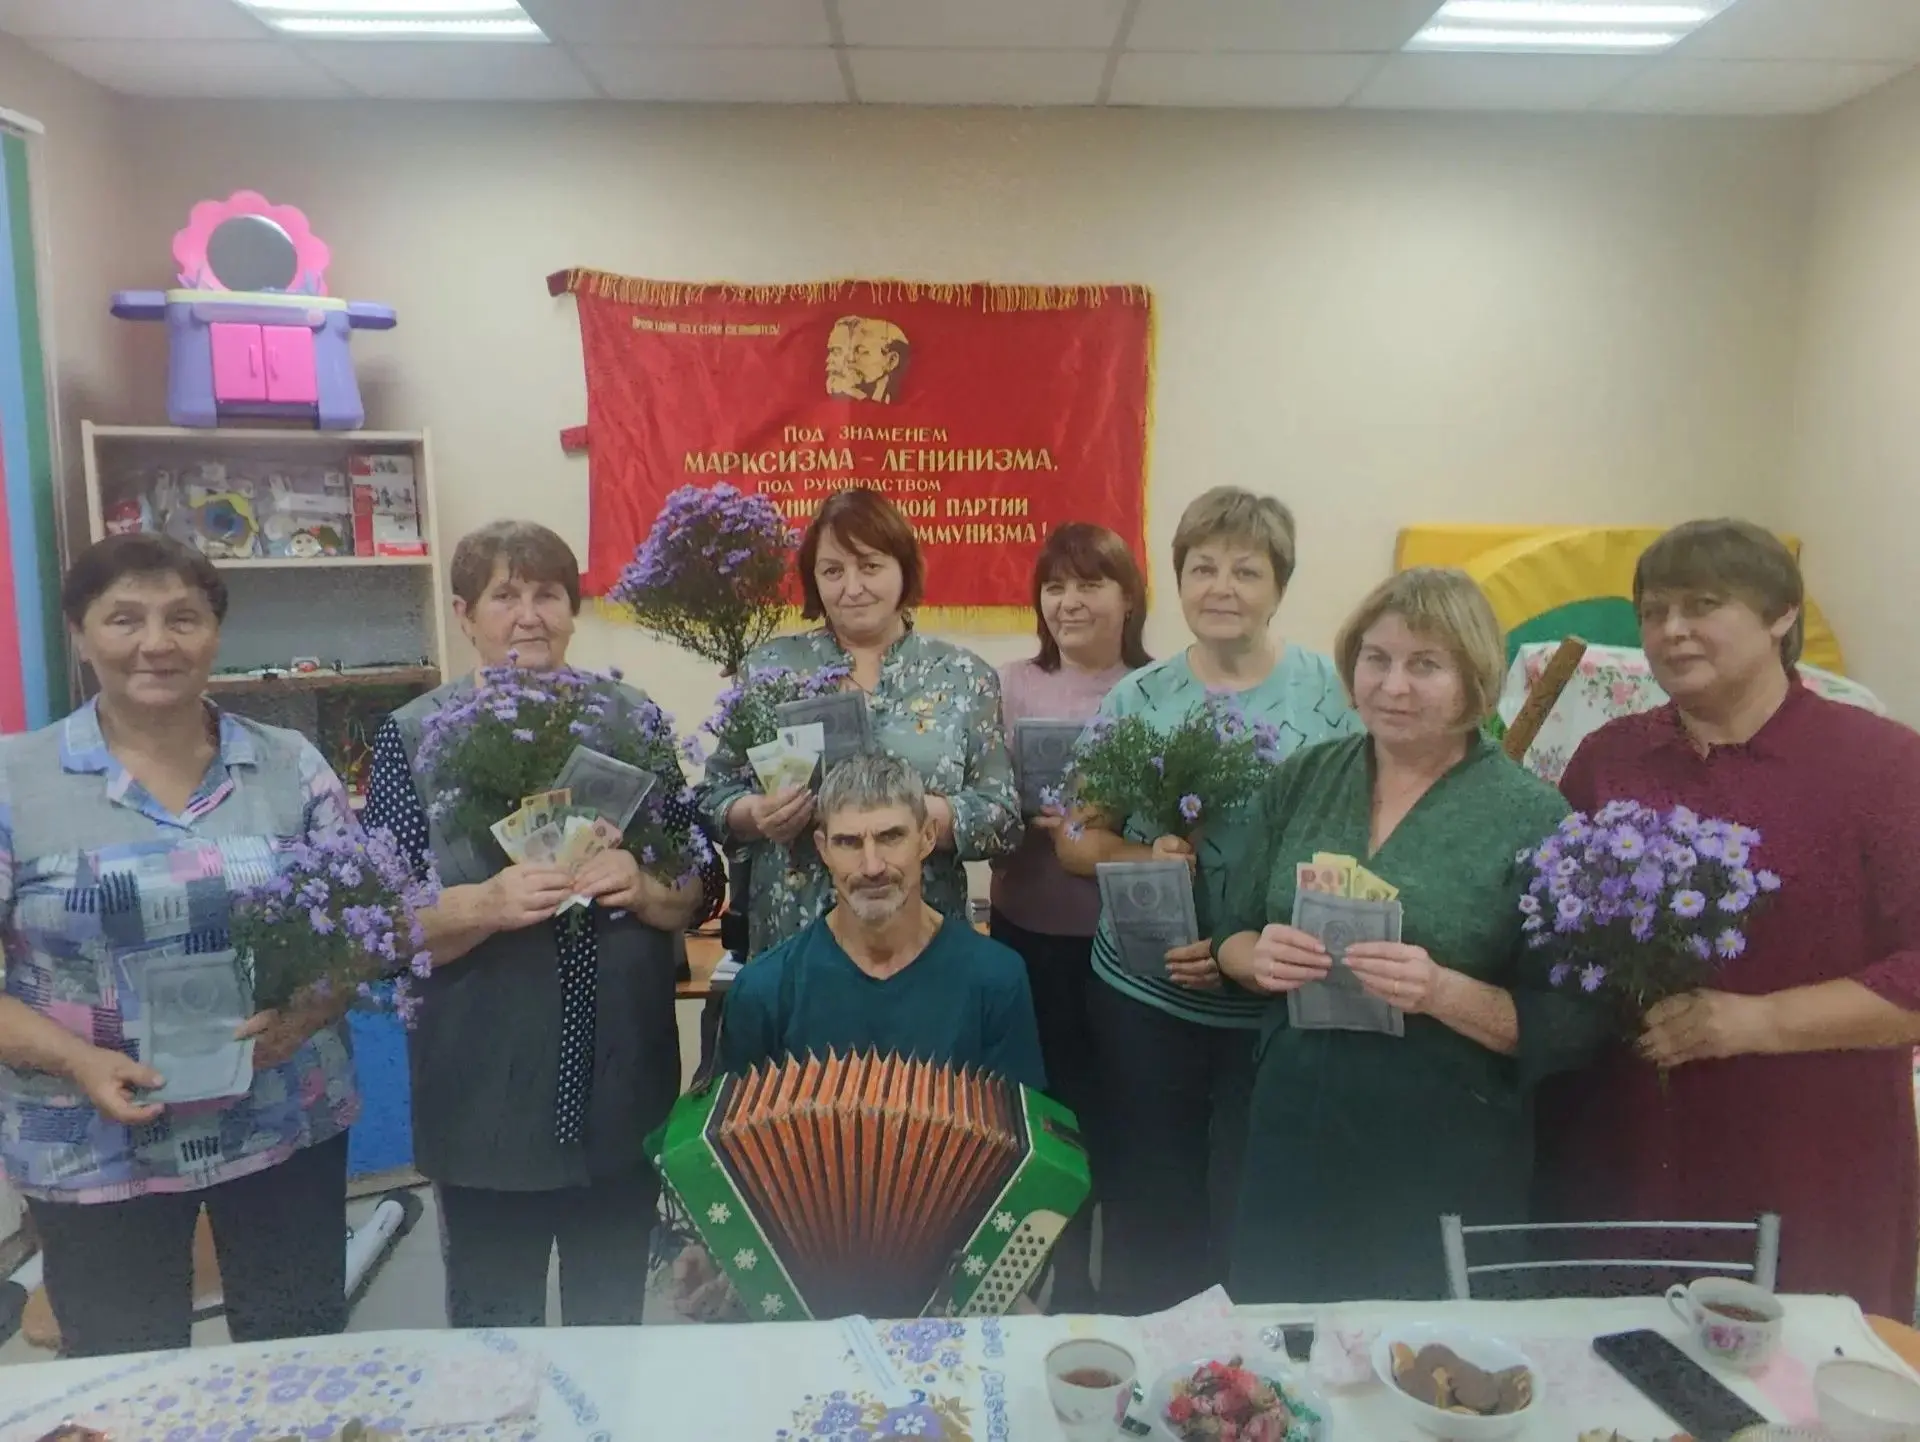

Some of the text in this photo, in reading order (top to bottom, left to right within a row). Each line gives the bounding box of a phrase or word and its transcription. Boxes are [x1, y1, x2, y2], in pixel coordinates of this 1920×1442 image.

[839, 425, 948, 442] ЗНАМЕНЕМ
[684, 448, 854, 474] МАРКСИЗМА
[757, 477, 941, 493] ПОД РУКОВОДСТВОМ
[946, 498, 1028, 516] ПАРТИИ
